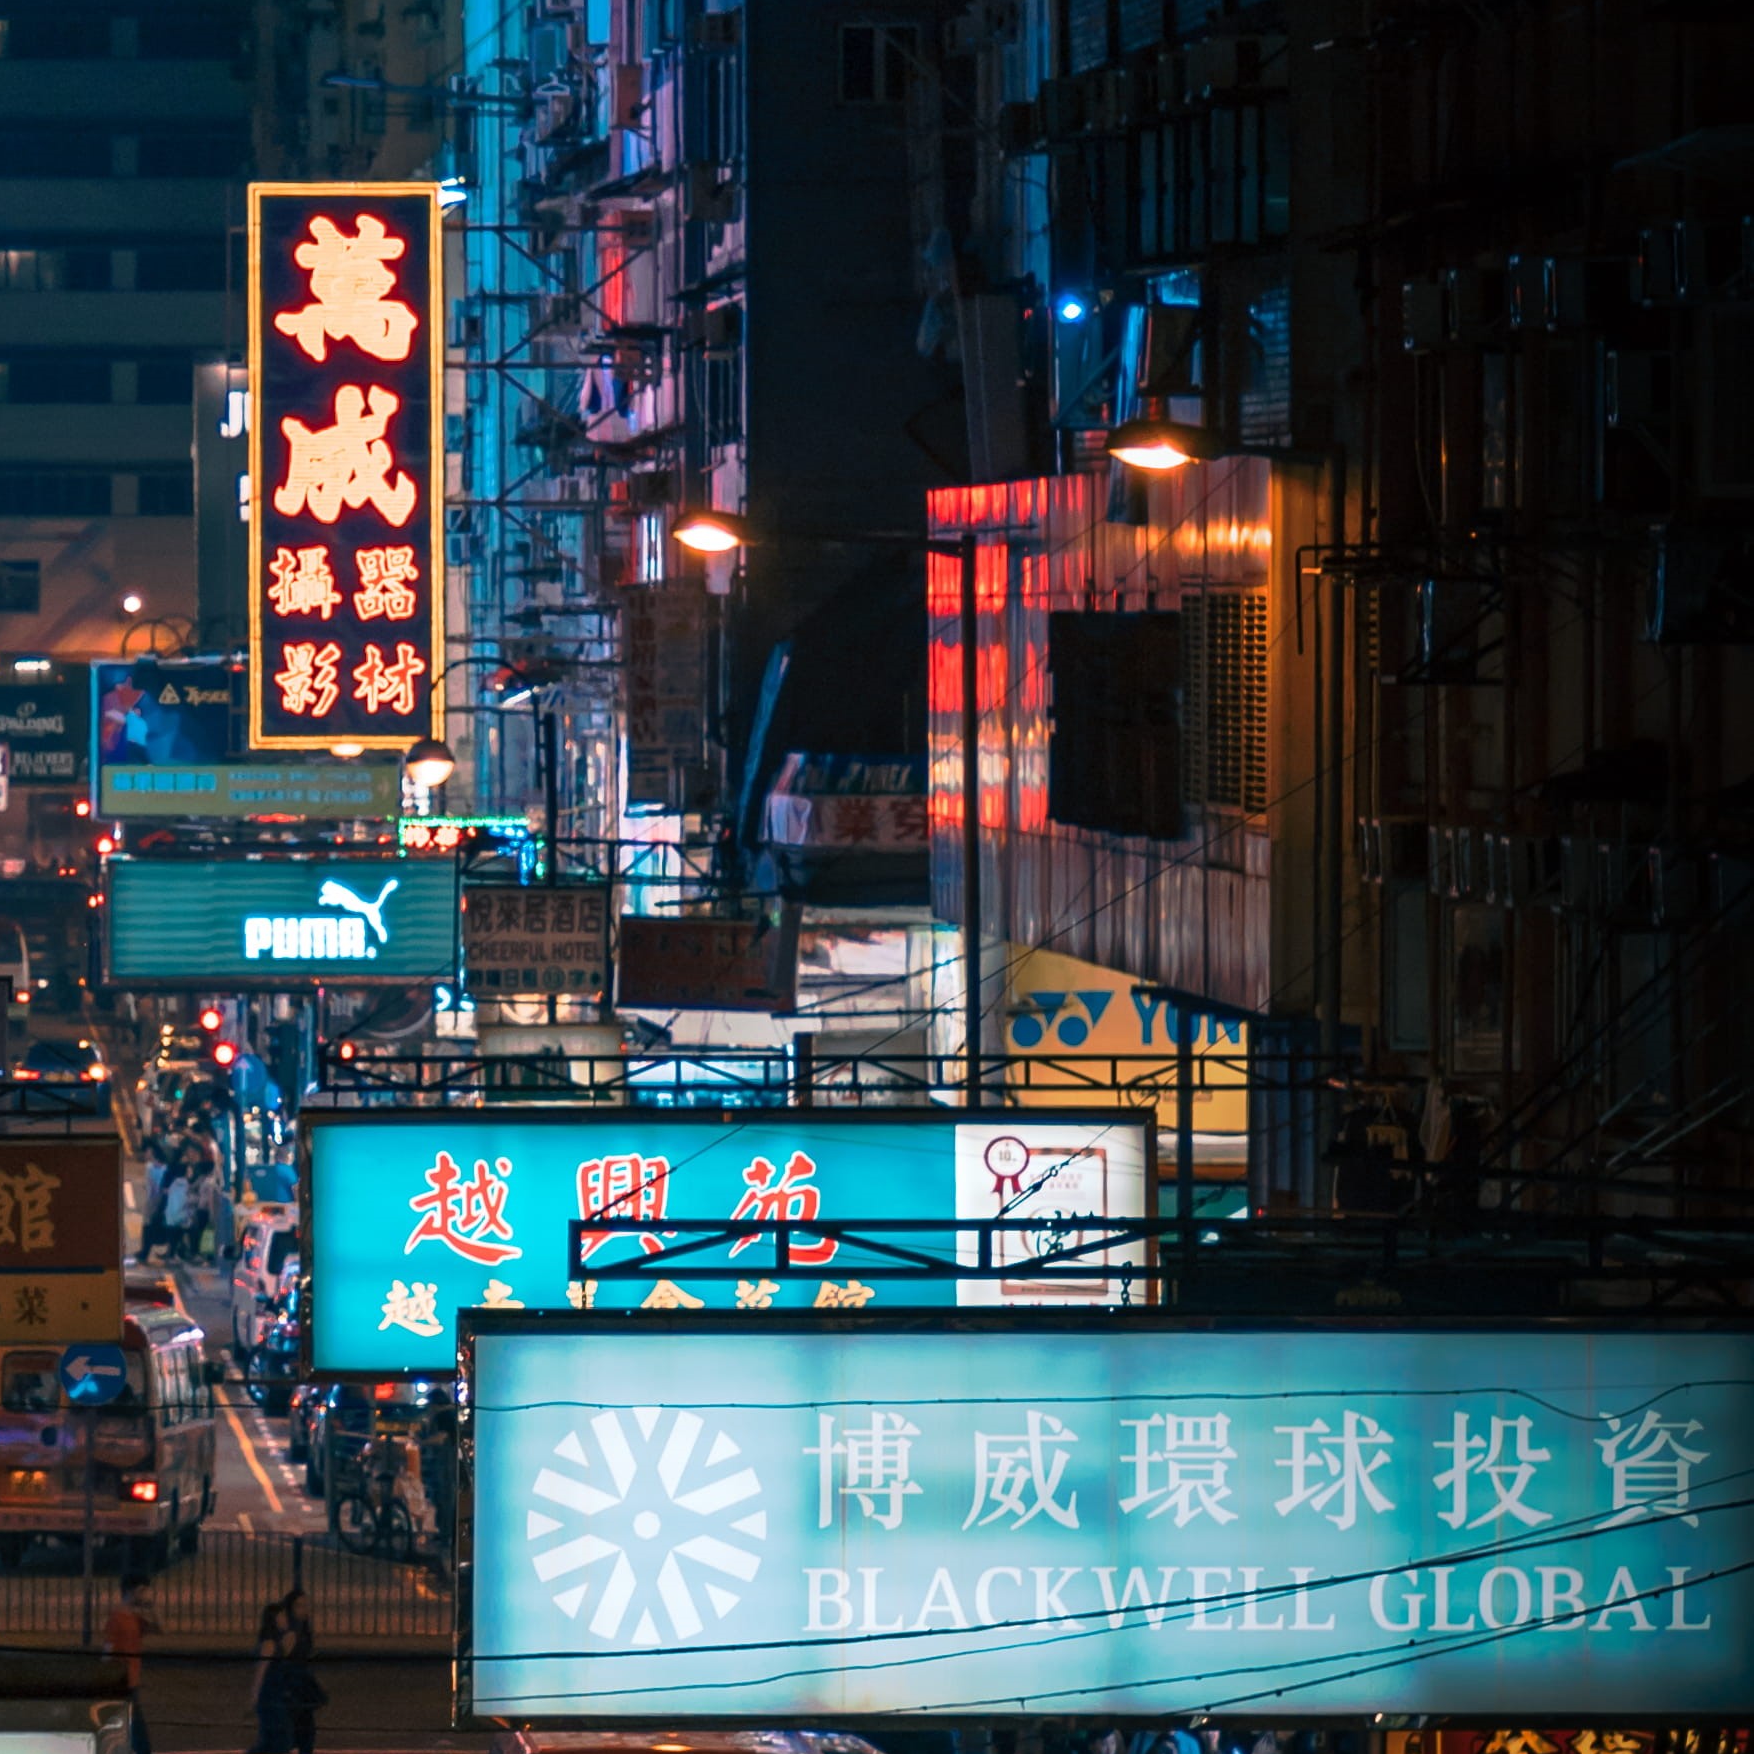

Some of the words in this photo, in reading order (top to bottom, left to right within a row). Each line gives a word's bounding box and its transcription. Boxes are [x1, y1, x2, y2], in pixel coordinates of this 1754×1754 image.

[274, 213, 418, 527] 萬成
[245, 916, 367, 959] PUMA
[552, 942, 602, 962] HOTEL
[802, 1408, 1711, 1530] 博威環球投資
[802, 1565, 1336, 1633] BLACKWELL
[1368, 1565, 1712, 1633] GLOBAL
